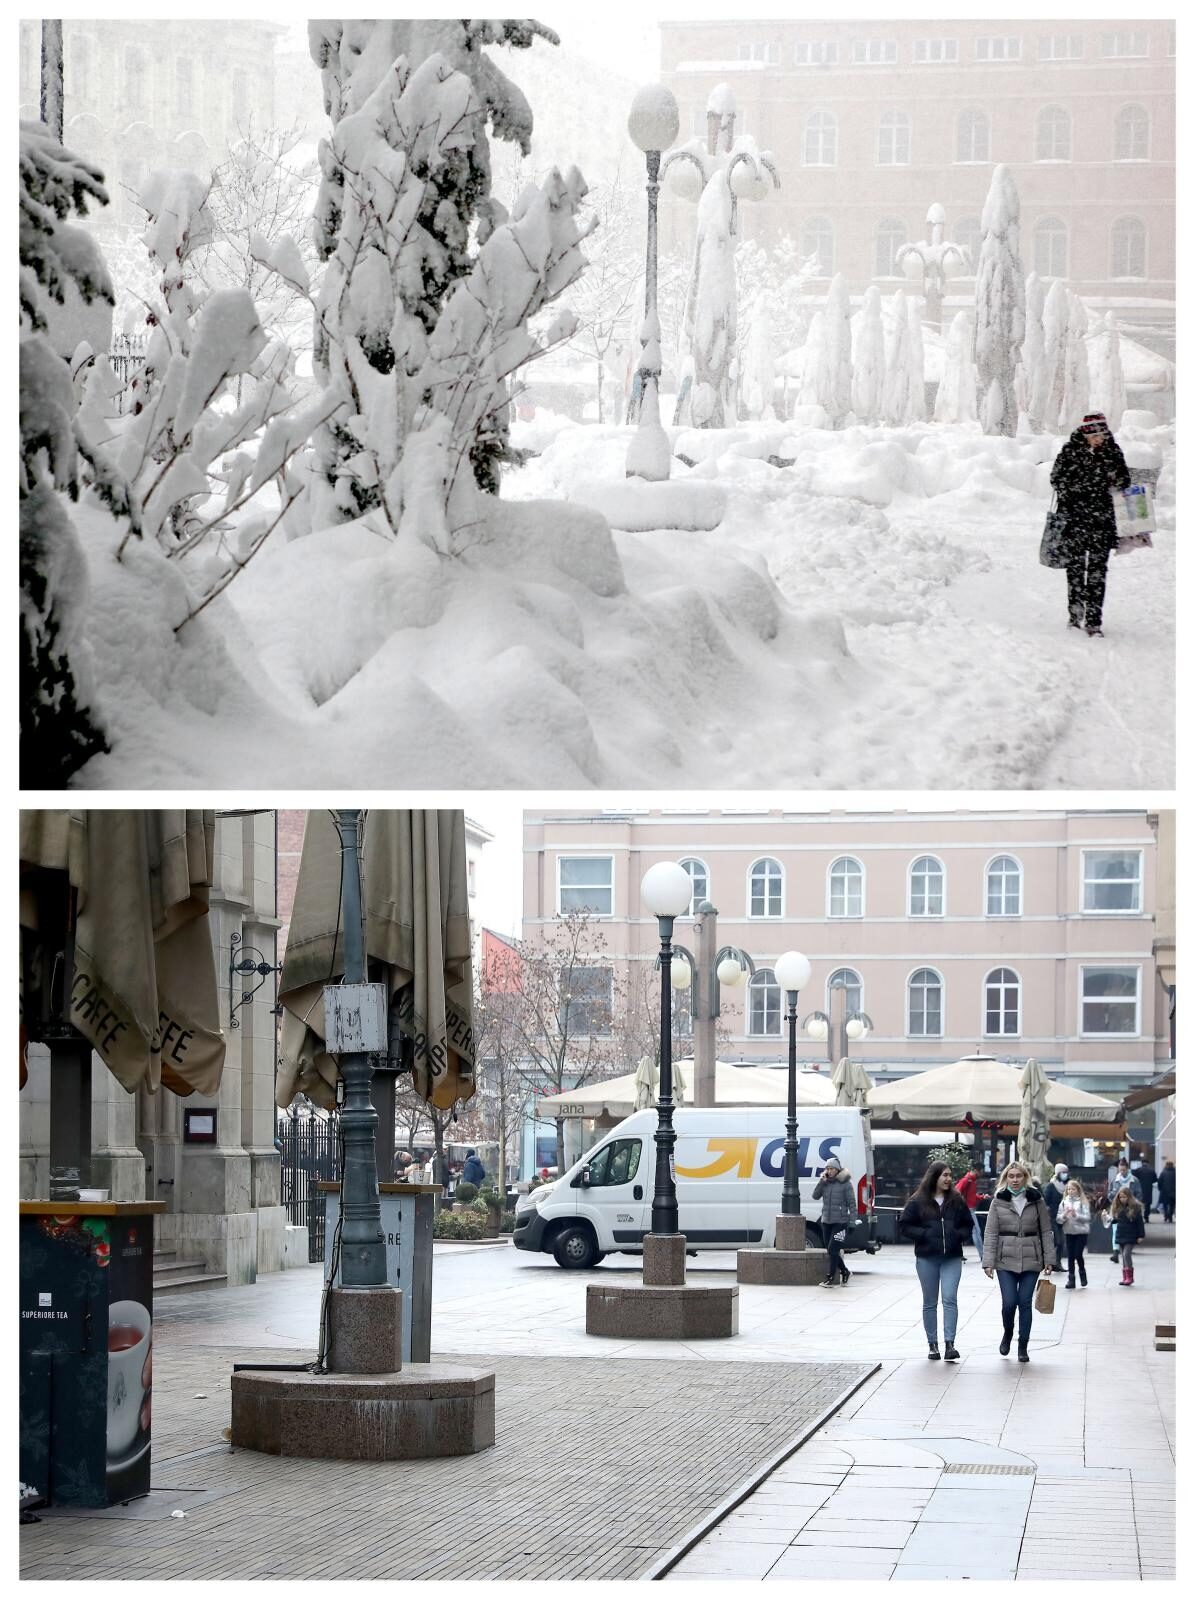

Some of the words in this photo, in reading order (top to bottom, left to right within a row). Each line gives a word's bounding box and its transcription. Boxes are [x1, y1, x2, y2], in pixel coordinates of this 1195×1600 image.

[760, 1137, 842, 1178] GLS
[21, 1310, 56, 1320] SUPERIORE
[56, 1310, 69, 1320] TEA
